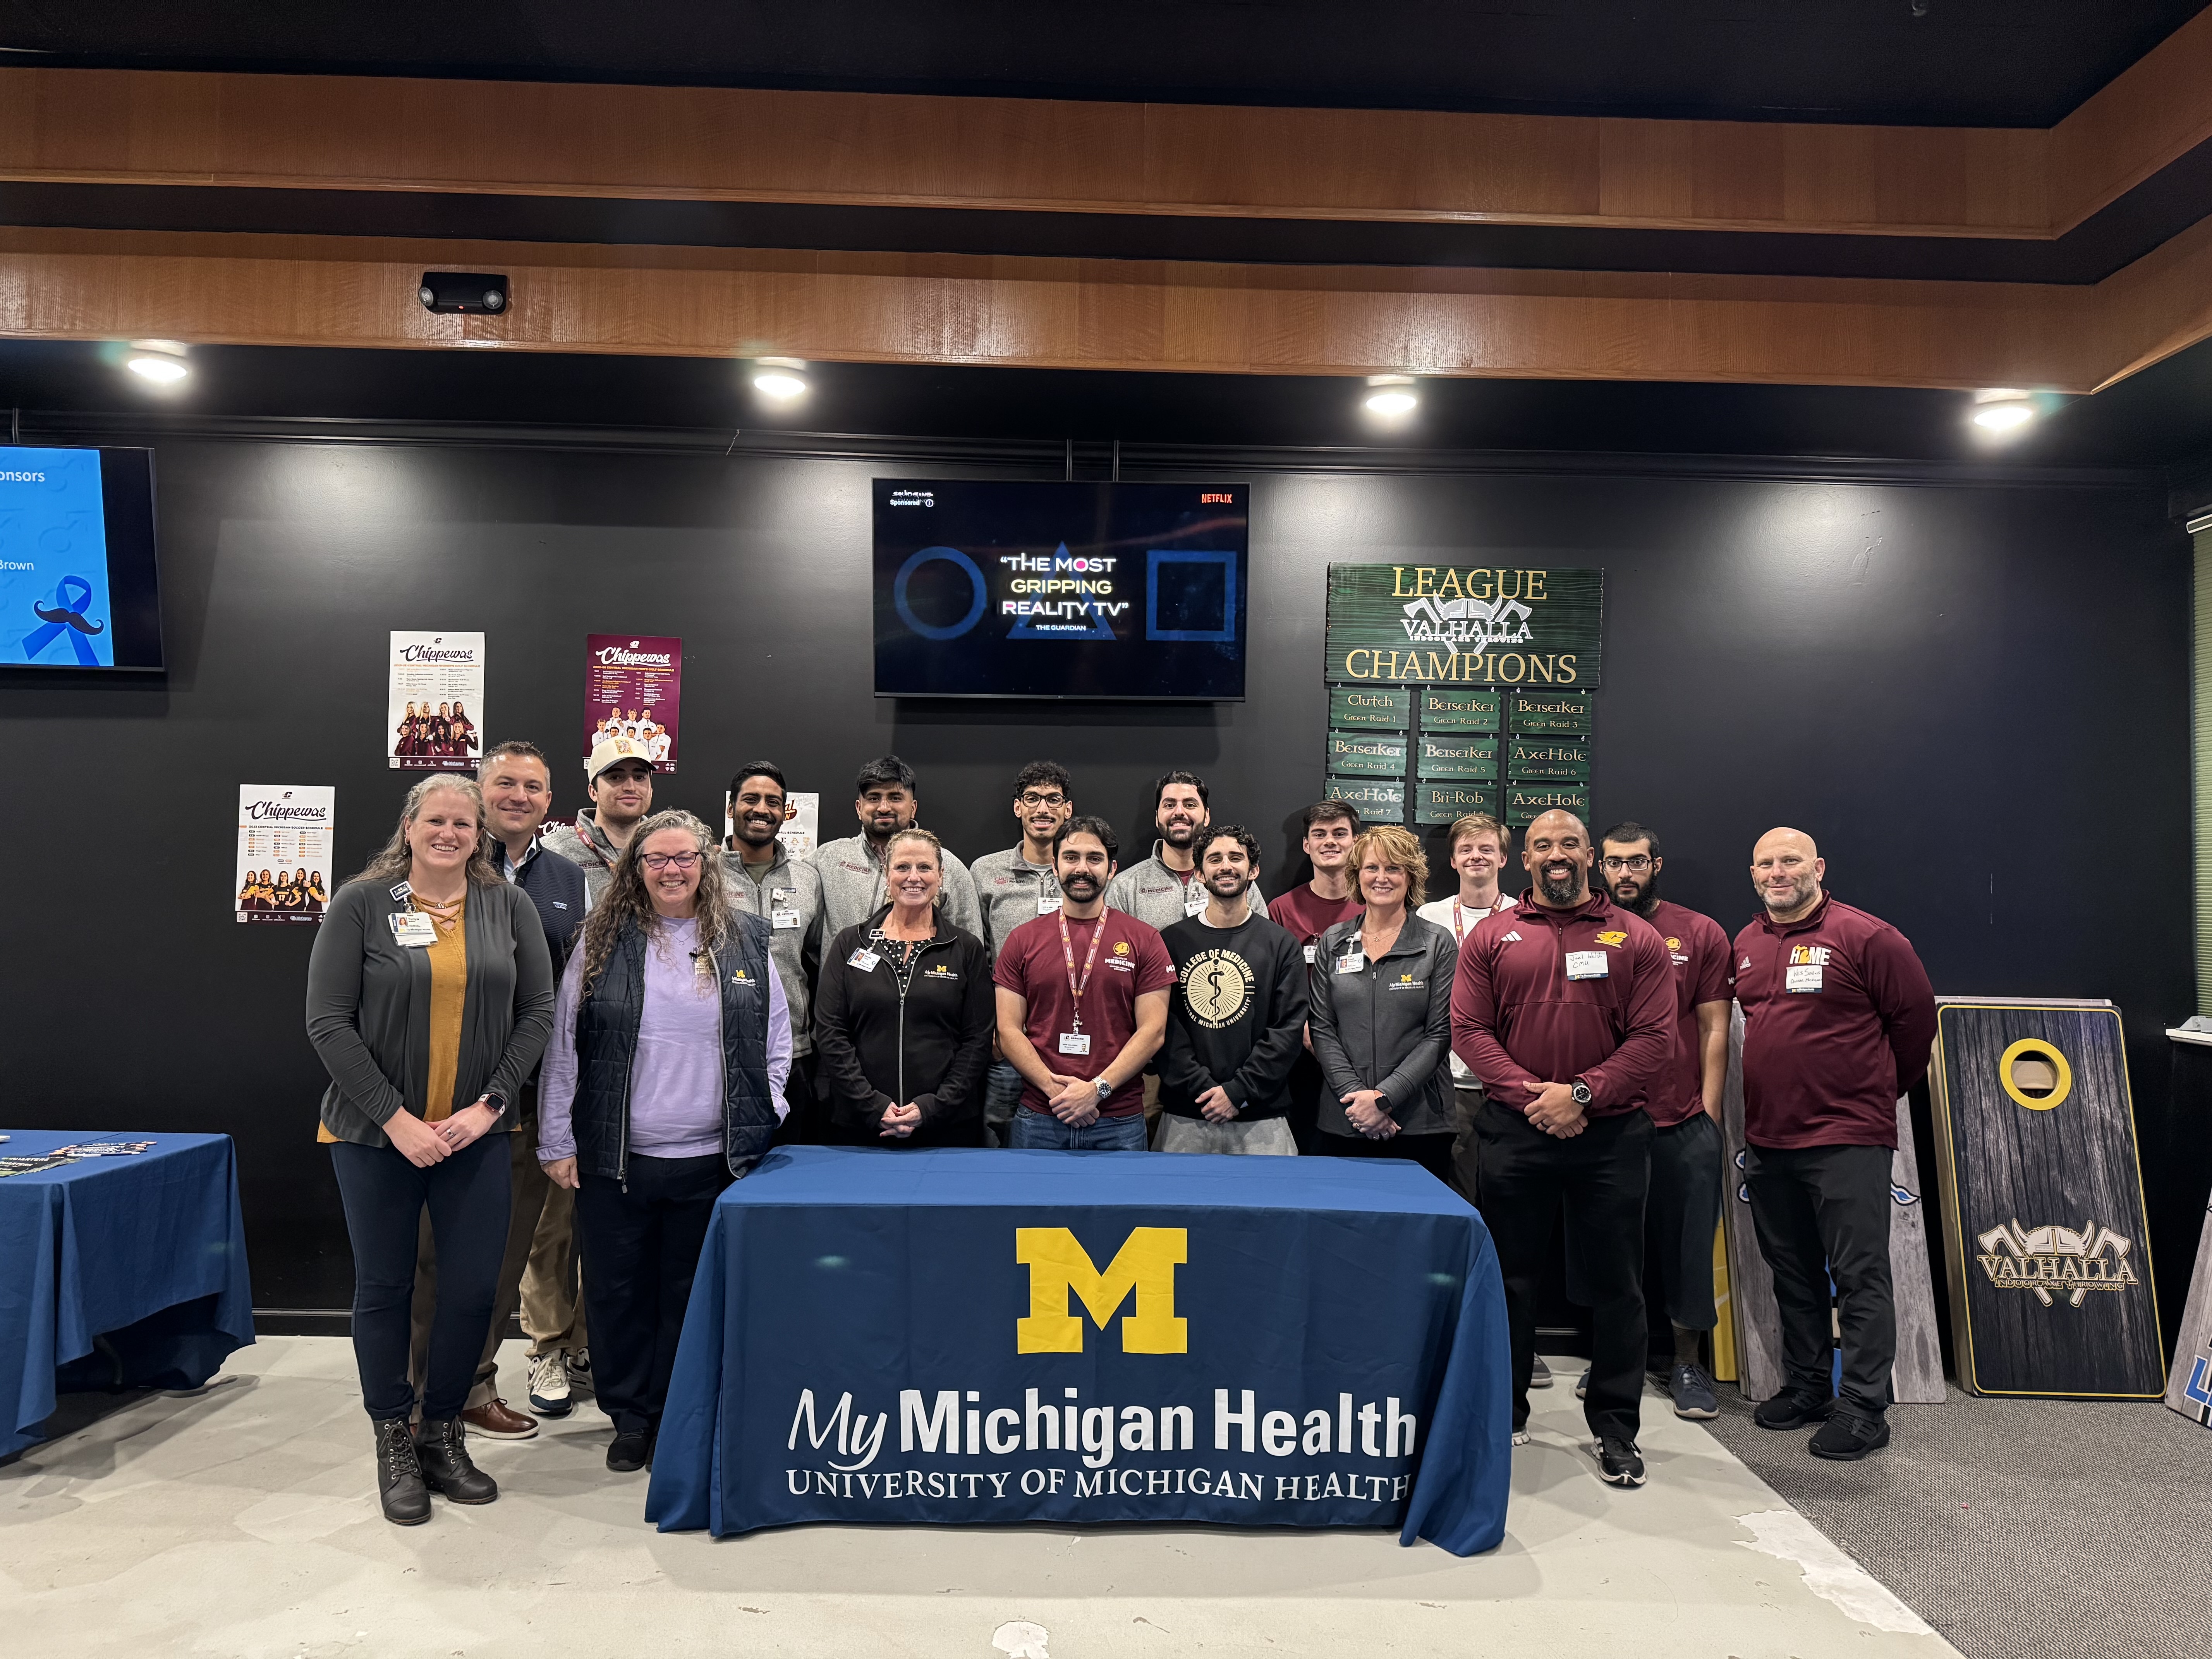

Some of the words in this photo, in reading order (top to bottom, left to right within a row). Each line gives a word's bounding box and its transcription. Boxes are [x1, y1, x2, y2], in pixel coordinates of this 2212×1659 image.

[0, 471, 45, 482] onsors
[1202, 494, 1232, 504] NETFLIX
[1055, 557, 1116, 572] MOST
[1011, 579, 1112, 594] GRIPPING
[1392, 567, 1547, 600] LEAGUE
[1002, 601, 1089, 620] REALITY
[1400, 619, 1534, 639] VALHALLA
[400, 645, 474, 662] Chippewas
[596, 647, 671, 667] Chippewas
[1345, 649, 1577, 684] CHAMPIONS
[1348, 694, 1393, 708] Clutch
[1428, 697, 1494, 712] Berserker
[1518, 699, 1584, 714] Berserker
[1334, 740, 1401, 756] Berserker
[1425, 744, 1492, 759] Berserker
[1513, 747, 1586, 761] AxeHole
[1329, 787, 1402, 803] AxeHole
[1431, 791, 1483, 804] Bri-Rob
[1512, 793, 1585, 806] AxeHole
[245, 801, 326, 821] Chippewas
[1104, 958, 1135, 969] MEDICINE
[1180, 951, 1208, 983] COLLEGE
[1208, 949, 1220, 958] OF
[1221, 949, 1255, 983] MEDICINE
[1401, 974, 1412, 982] M
[1198, 1019, 1225, 1029] MICHIGAN
[1226, 996, 1251, 1026] UNIVERSITY
[1977, 1255, 2138, 1285] VALHALLA
[1016, 1226, 1187, 1355] M
[1995, 1279, 2037, 1288] INDOOR
[2042, 1280, 2063, 1289] AXE
[2065, 1281, 2125, 1291] THROWING
[788, 1388, 888, 1471] My
[900, 1388, 1193, 1468] Michigan
[1215, 1389, 1416, 1457] Health
[785, 1469, 1011, 1499] UNIVERSITY
[1020, 1468, 1066, 1495] OF
[1073, 1467, 1265, 1501] MICHIGAN
[1274, 1472, 1411, 1502] HEALTH
